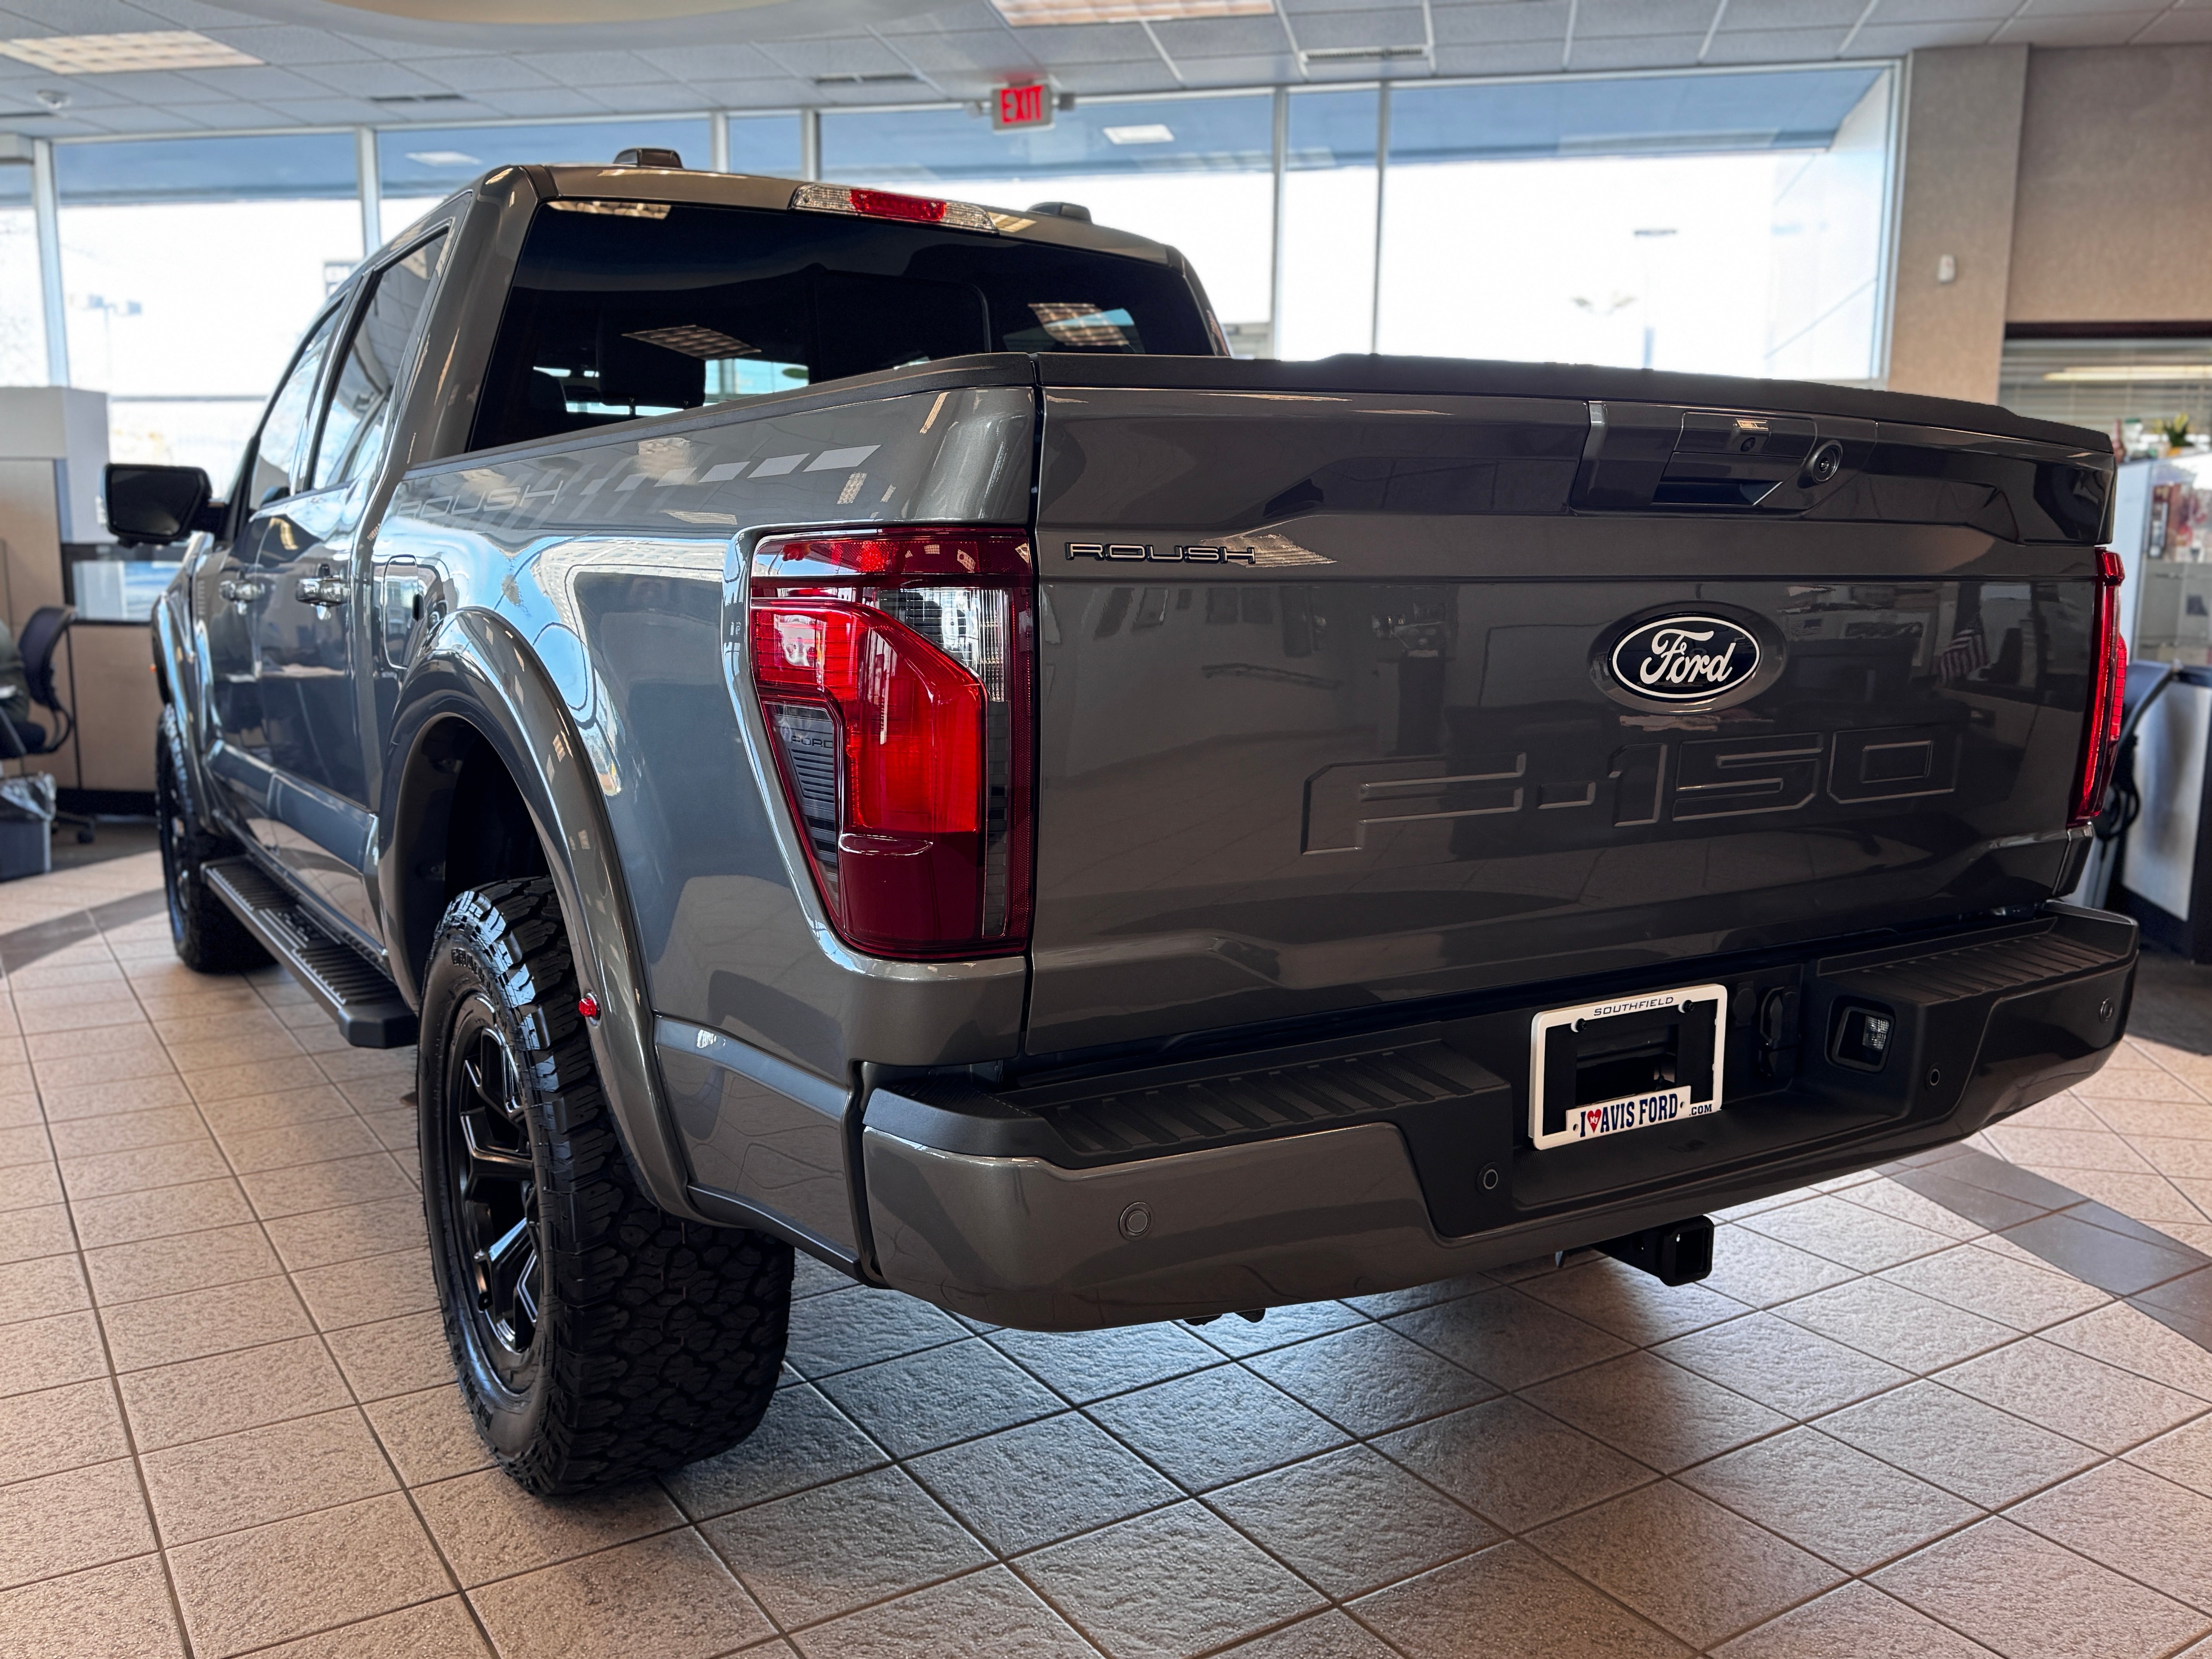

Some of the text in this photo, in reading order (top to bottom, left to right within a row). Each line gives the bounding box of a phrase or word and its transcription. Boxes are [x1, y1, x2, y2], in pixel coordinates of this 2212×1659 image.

[1000, 84, 1042, 124] EXIT
[396, 480, 563, 520] ROUSH
[1065, 542, 1255, 564] ROUSH
[1640, 629, 1736, 684] Ford
[1300, 723, 1962, 855] F-150
[1594, 997, 1674, 1016] SOUTHFIELD
[1580, 1111, 1586, 1137] I
[1601, 1101, 1635, 1133] AVIS
[1639, 1094, 1678, 1125] FORD
[1689, 1104, 1712, 1116] .COM
